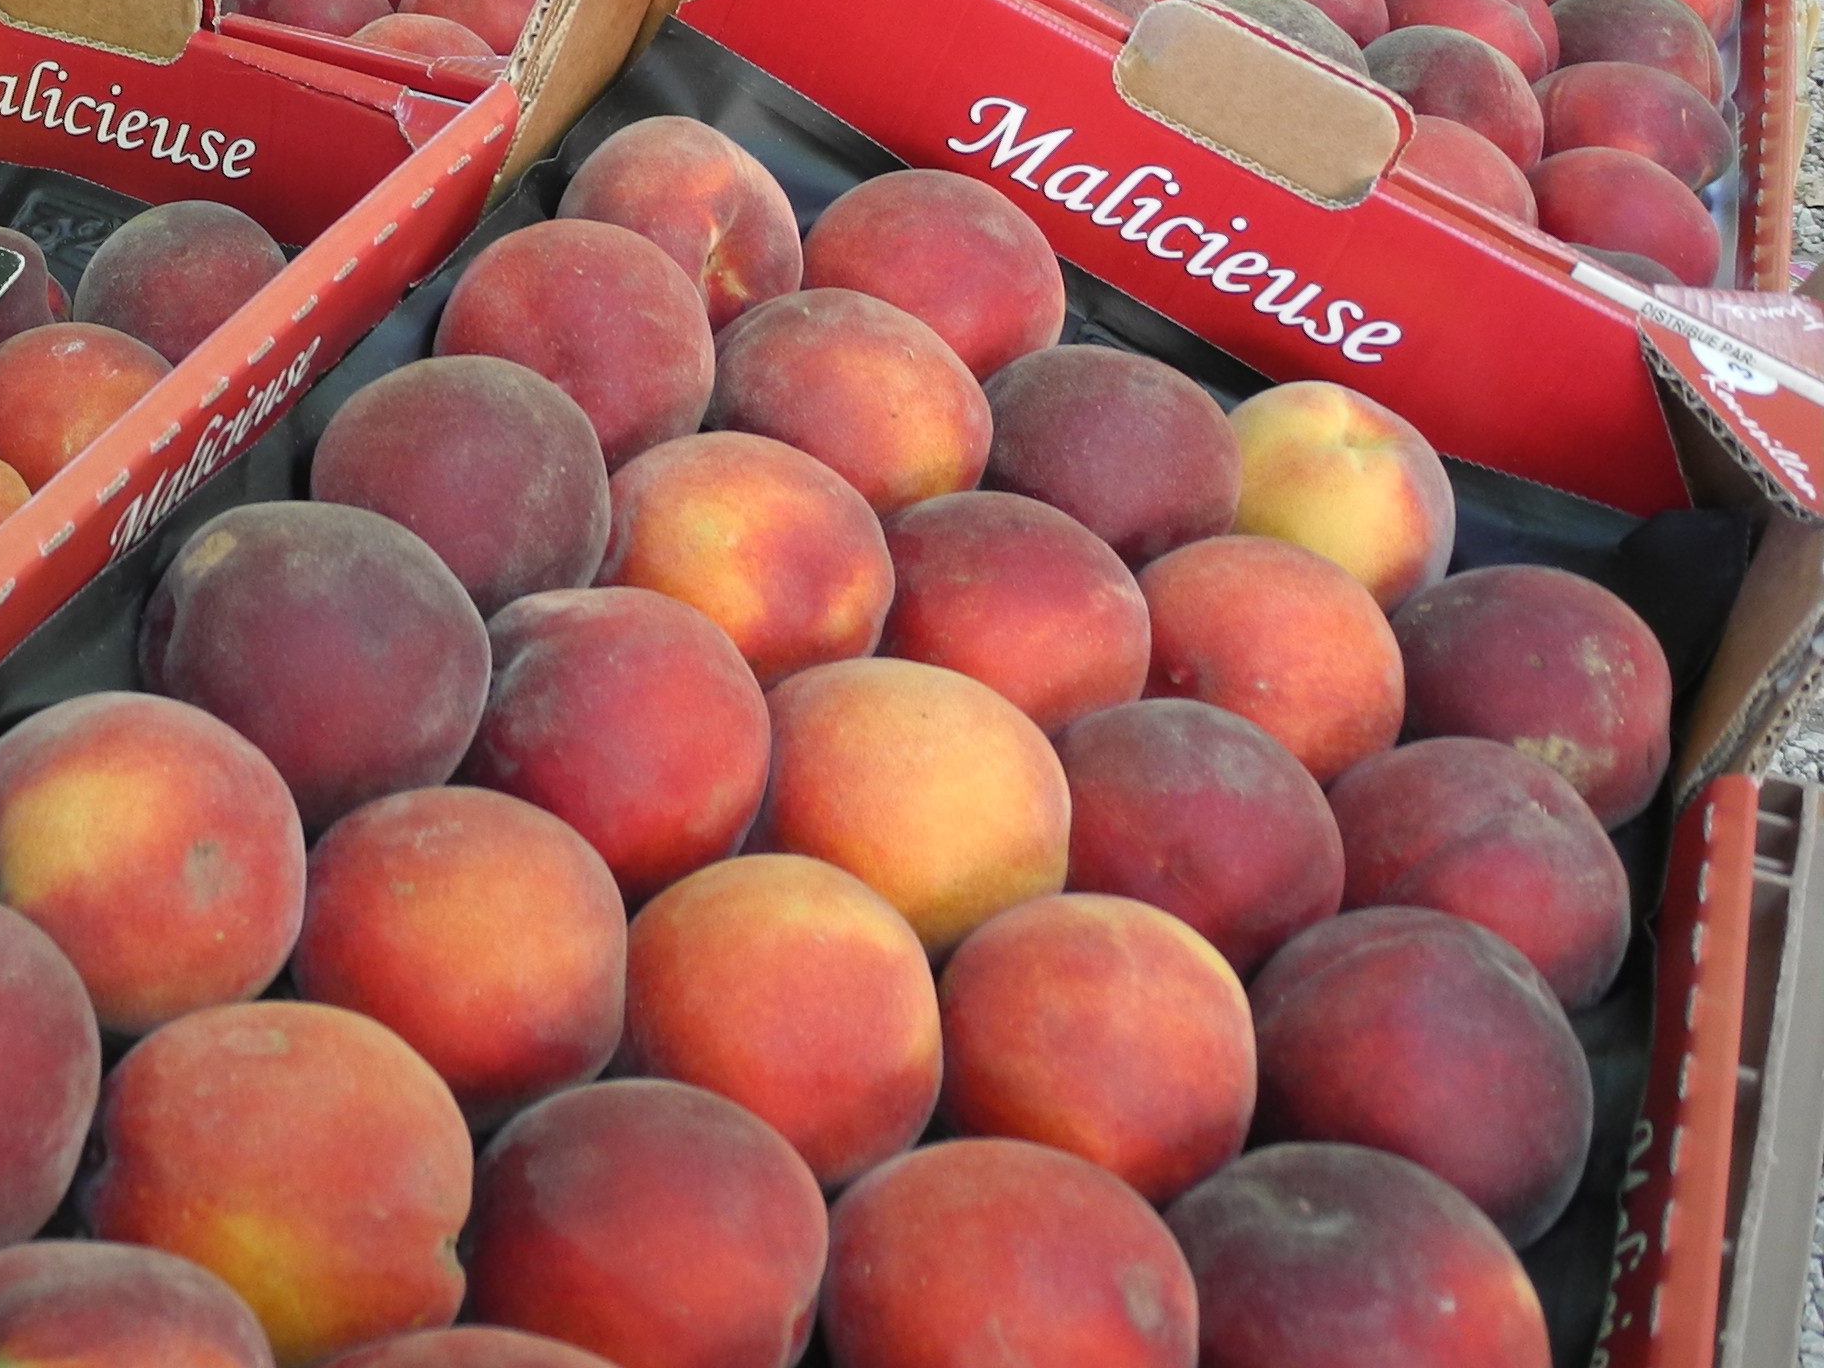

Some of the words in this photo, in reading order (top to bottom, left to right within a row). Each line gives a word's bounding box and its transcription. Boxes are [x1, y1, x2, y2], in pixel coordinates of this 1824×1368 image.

[945, 94, 1405, 366] Malicieuse
[1640, 300, 1719, 351] DISTRIBUE
[109, 335, 323, 562] Malicieuse
